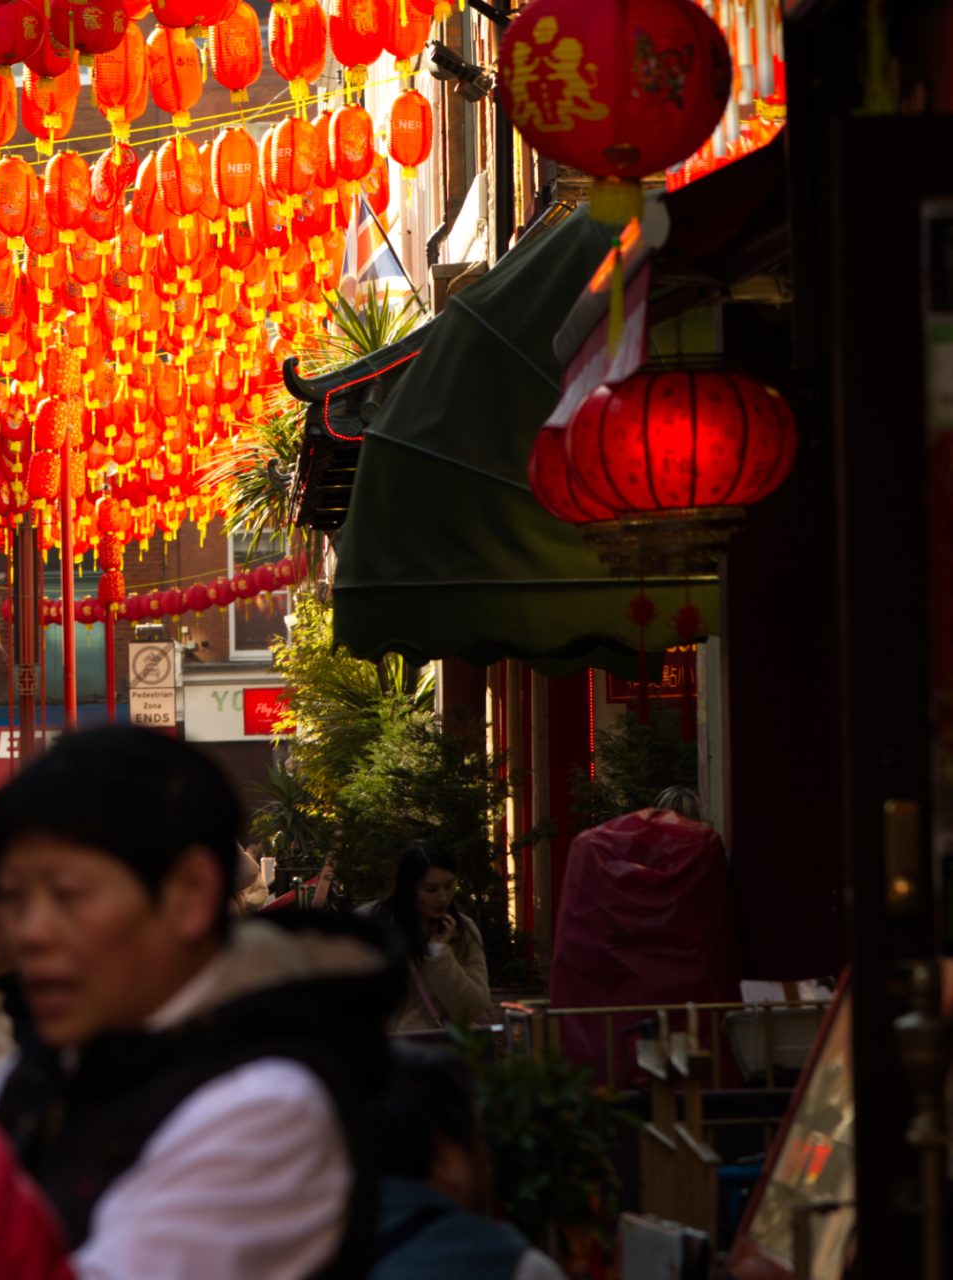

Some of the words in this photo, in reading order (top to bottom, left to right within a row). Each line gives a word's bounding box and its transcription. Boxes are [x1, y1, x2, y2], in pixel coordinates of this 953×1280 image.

[226, 162, 252, 174] NER
[132, 691, 173, 700] Pedestrian
[142, 702, 162, 710] Zone
[135, 713, 170, 724] ENDS
